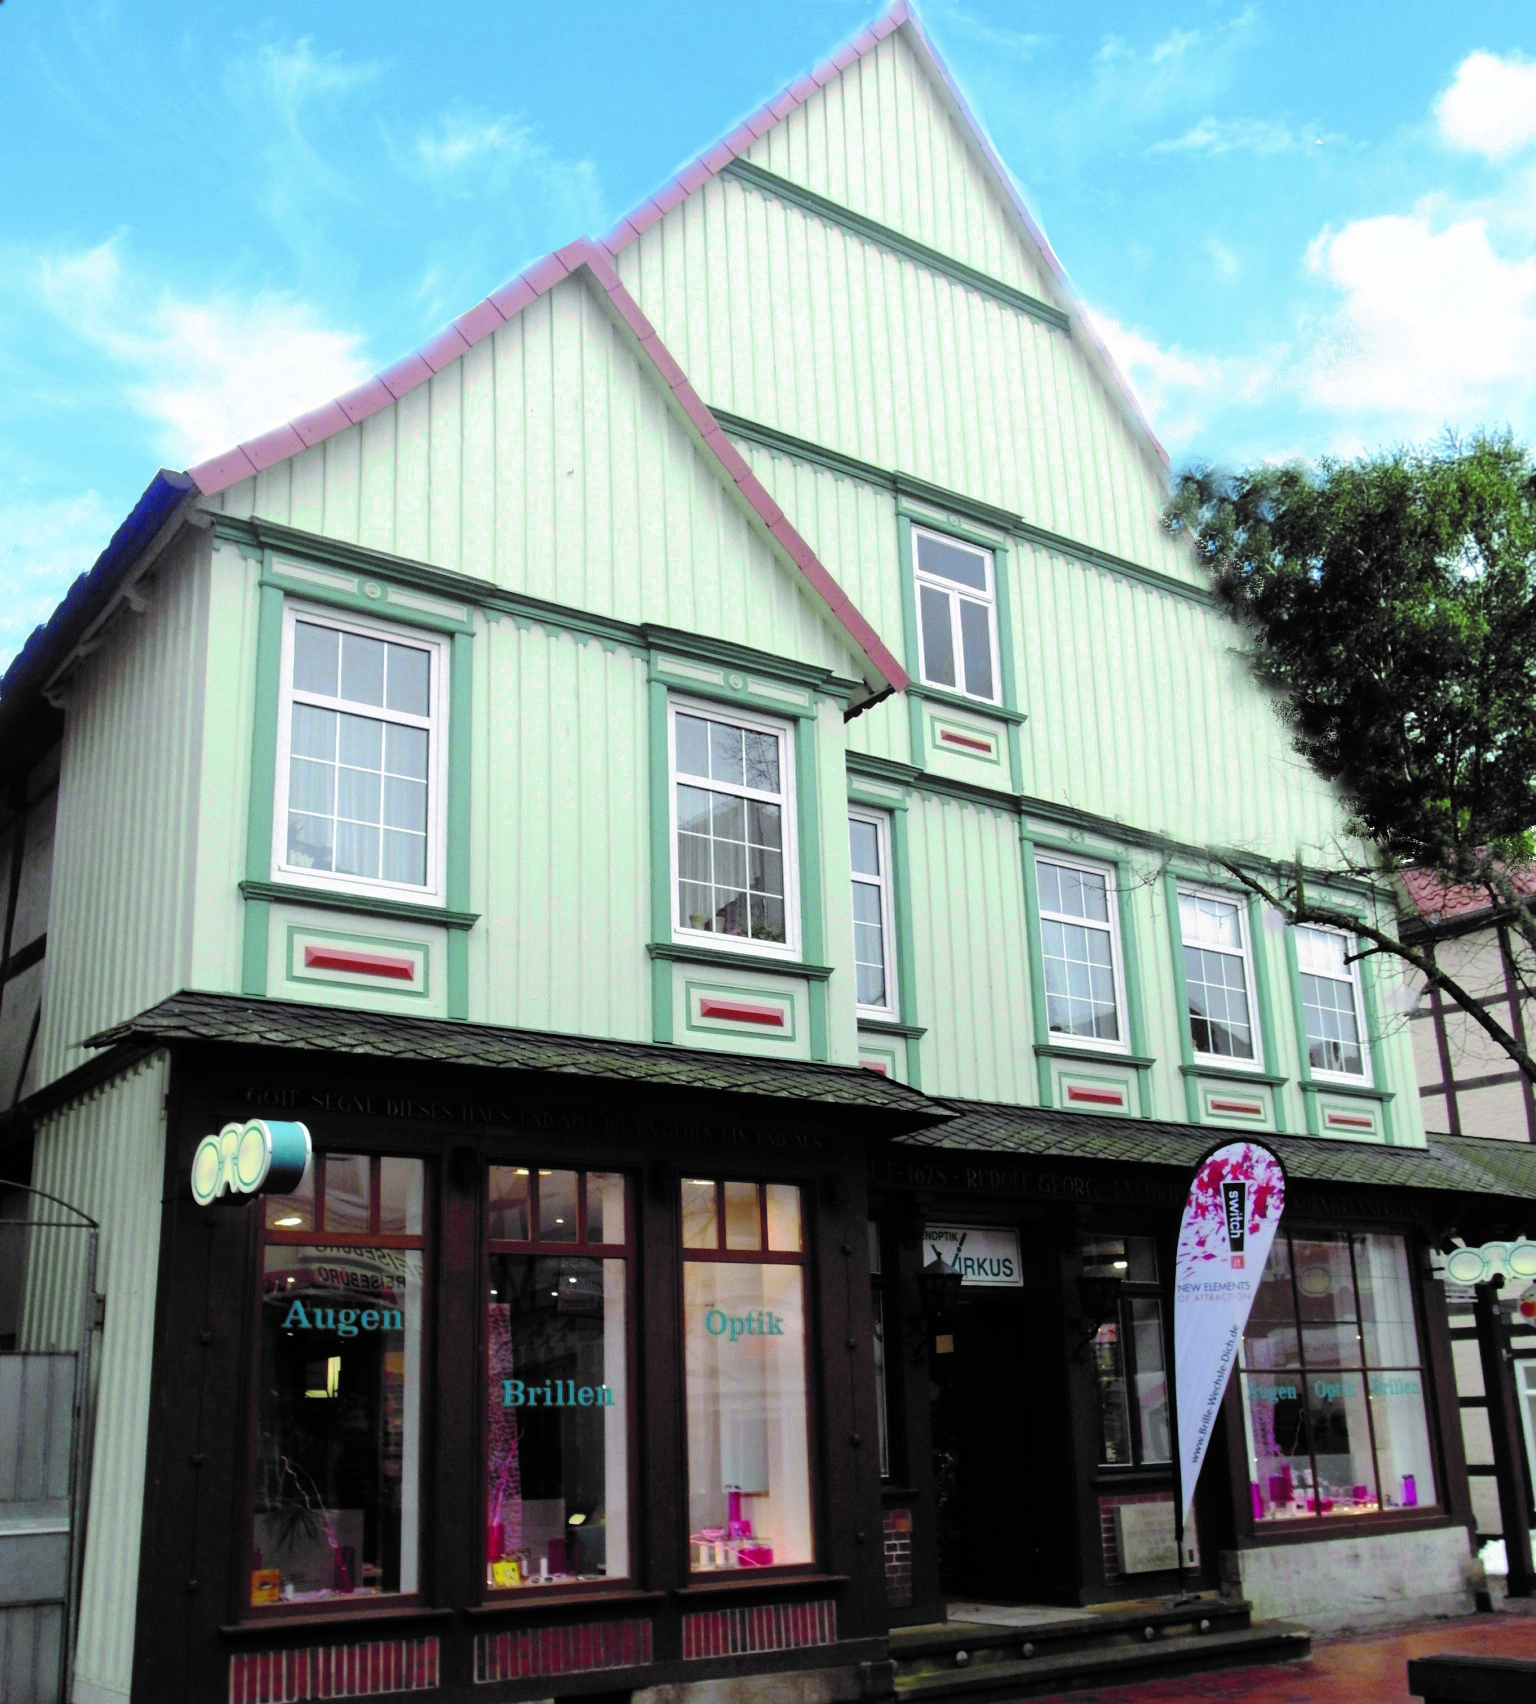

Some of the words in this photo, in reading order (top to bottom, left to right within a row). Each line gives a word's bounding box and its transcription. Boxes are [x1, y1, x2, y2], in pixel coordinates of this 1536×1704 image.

[246, 1087, 300, 1107] GOTT
[310, 1092, 376, 1115] SEGNE
[387, 1098, 453, 1119] DIESES
[462, 1105, 512, 1124] HAUS
[519, 1110, 554, 1129] UND
[966, 1168, 1030, 1191] RUDOLF
[1038, 1174, 1098, 1197] GEORG
[1228, 1190, 1244, 1239] switch
[1177, 1284, 1201, 1293] NEW
[1204, 1281, 1251, 1292] ELEMENTS
[1177, 1294, 1189, 1303] OF
[1194, 1292, 1251, 1302] ATTRACTION
[281, 1300, 403, 1337] Augen
[705, 1310, 784, 1341] Optik
[502, 1379, 615, 1407] Brillen
[1192, 1324, 1239, 1464] www.Brille-Wechsle-Dich.de
[1250, 1383, 1297, 1404] Augen
[1314, 1379, 1355, 1402] Optik
[1372, 1378, 1419, 1396] Brillen
